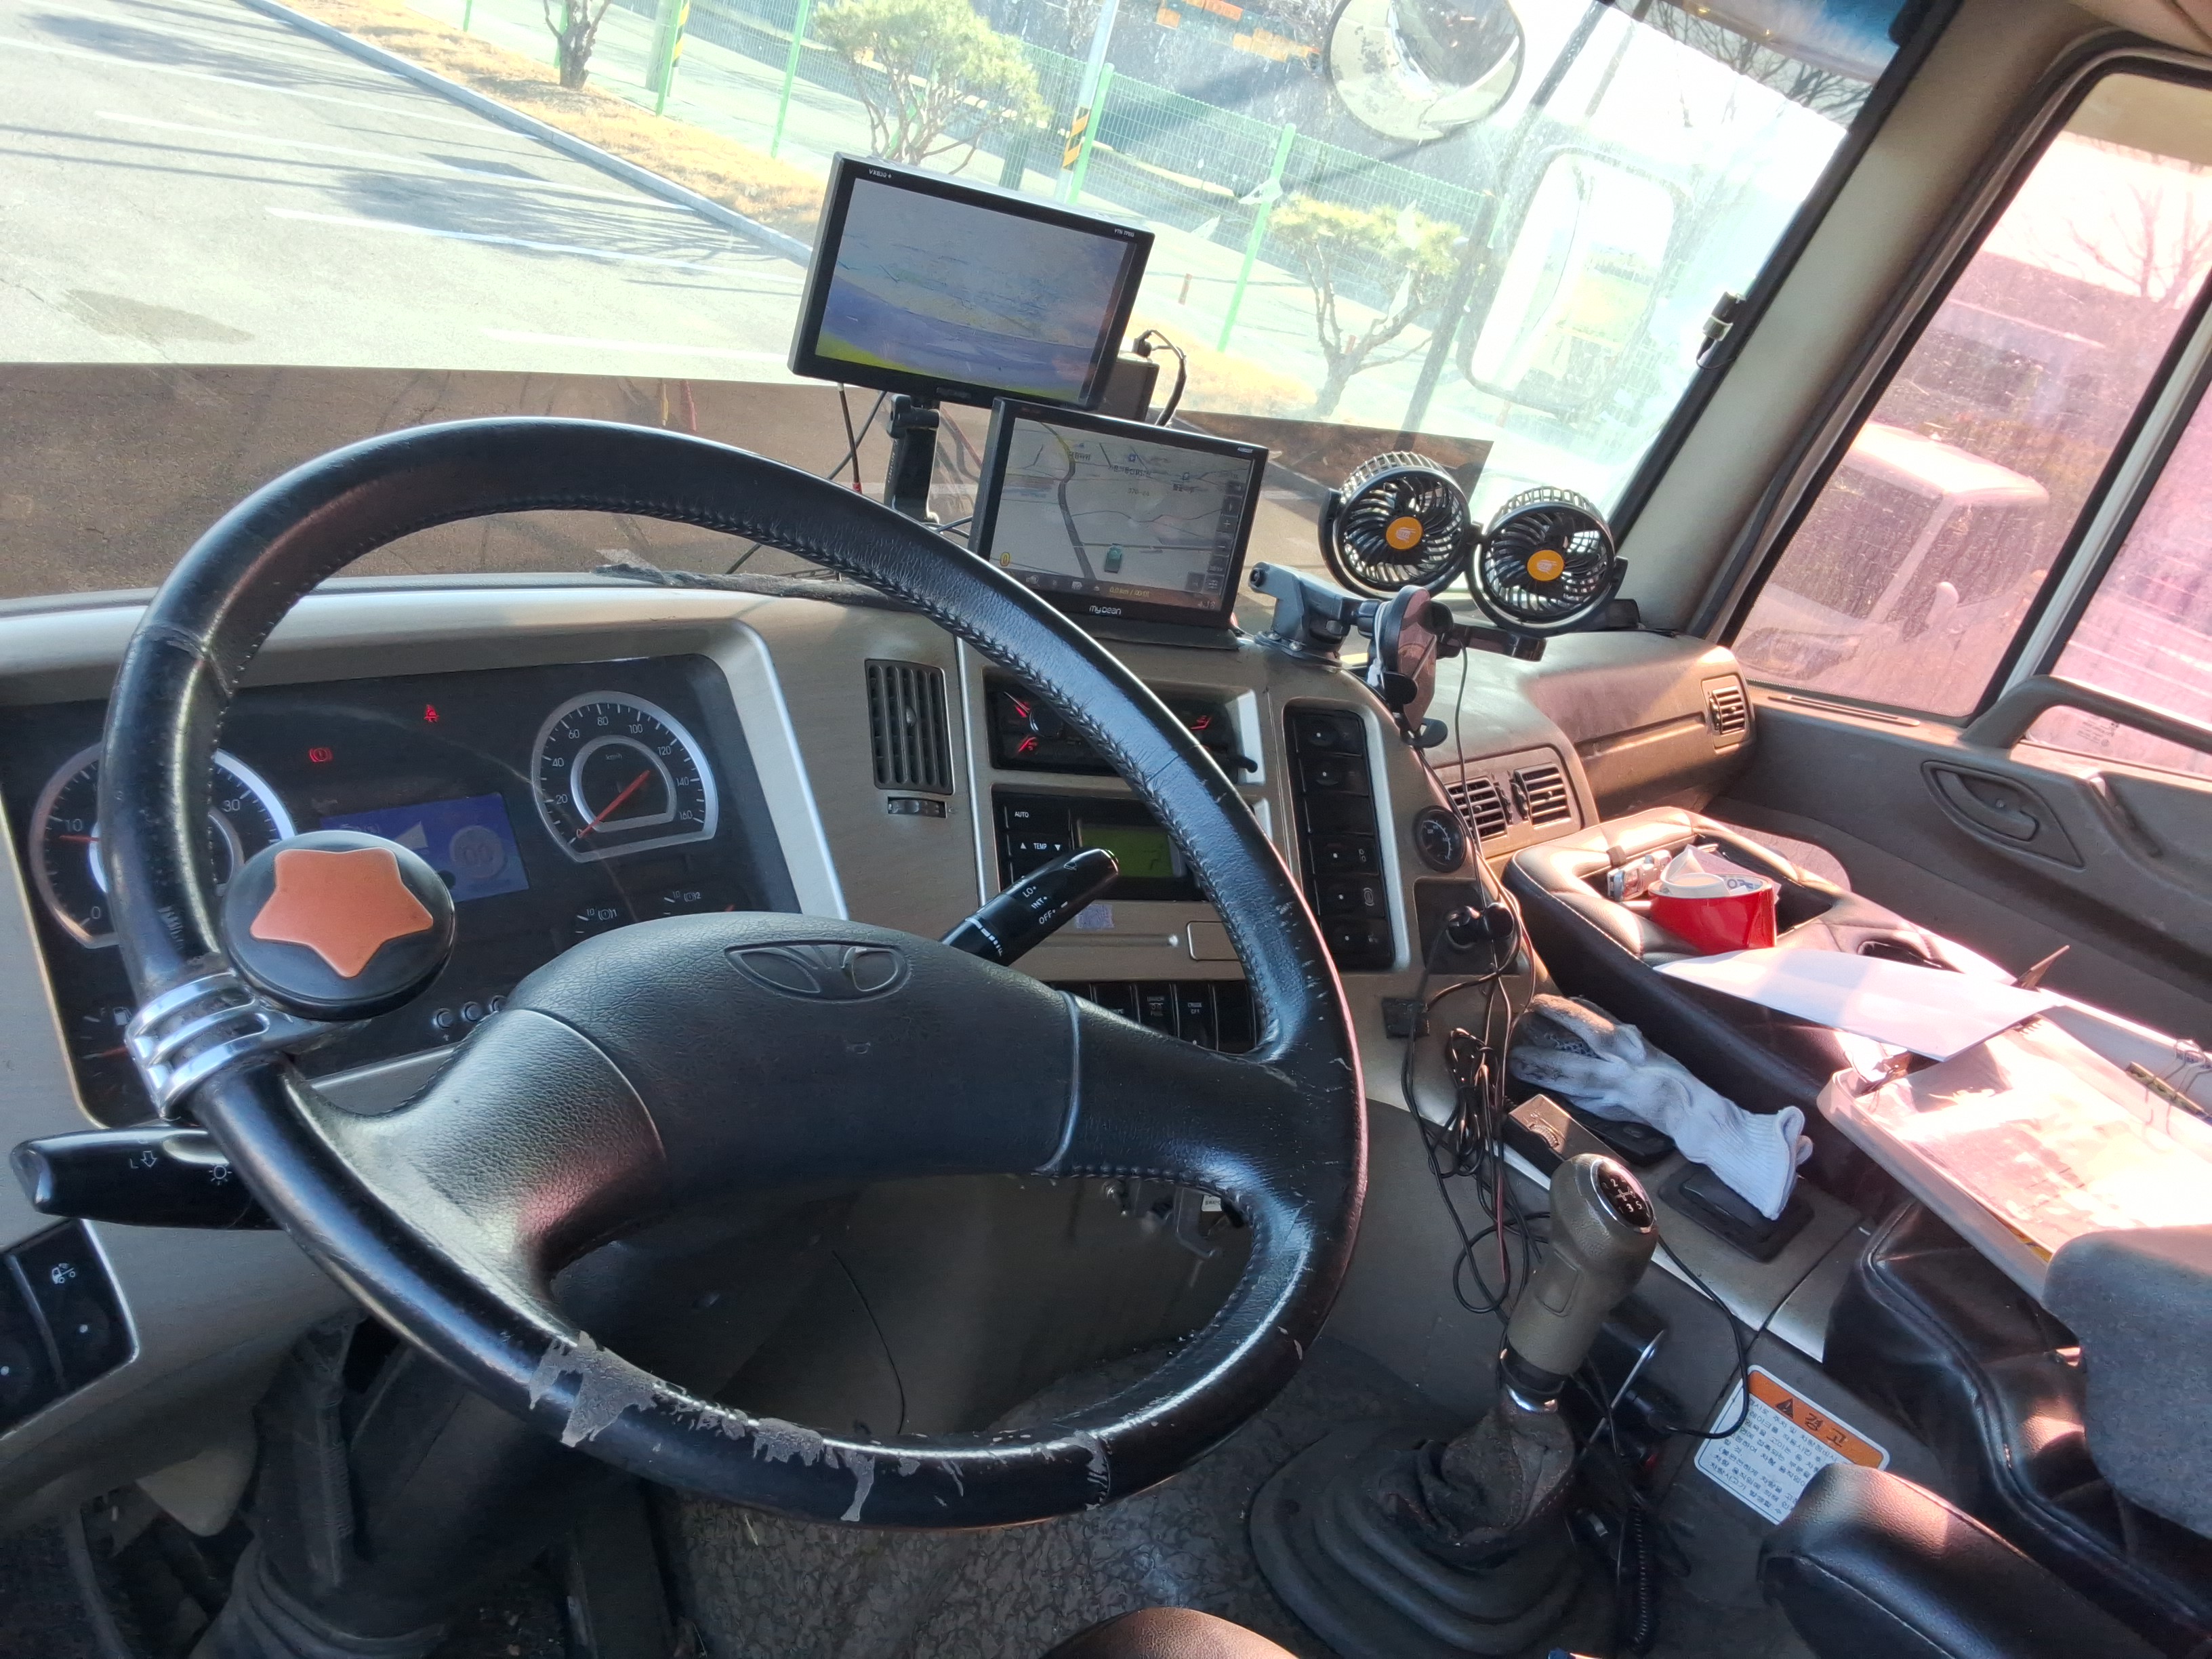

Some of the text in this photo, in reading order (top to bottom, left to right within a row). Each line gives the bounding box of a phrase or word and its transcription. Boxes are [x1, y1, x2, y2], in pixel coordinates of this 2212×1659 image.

[597, 716, 609, 726] 80
[568, 729, 580, 739] 60
[629, 724, 643, 734] 100
[657, 746, 672, 756] 120
[552, 758, 565, 767] 40
[677, 777, 690, 786] 140
[556, 794, 568, 804] 20
[222, 799, 241, 813] 30
[680, 811, 693, 820] 160
[65, 819, 83, 832] 10
[1022, 887, 1033, 898] LO
[1031, 898, 1044, 909] INT
[91, 906, 100, 920] 0
[1039, 911, 1053, 924] OFF
[1610, 1179, 1618, 1187] 2
[1626, 1204, 1634, 1212] 3
[1635, 1201, 1643, 1210] 5
